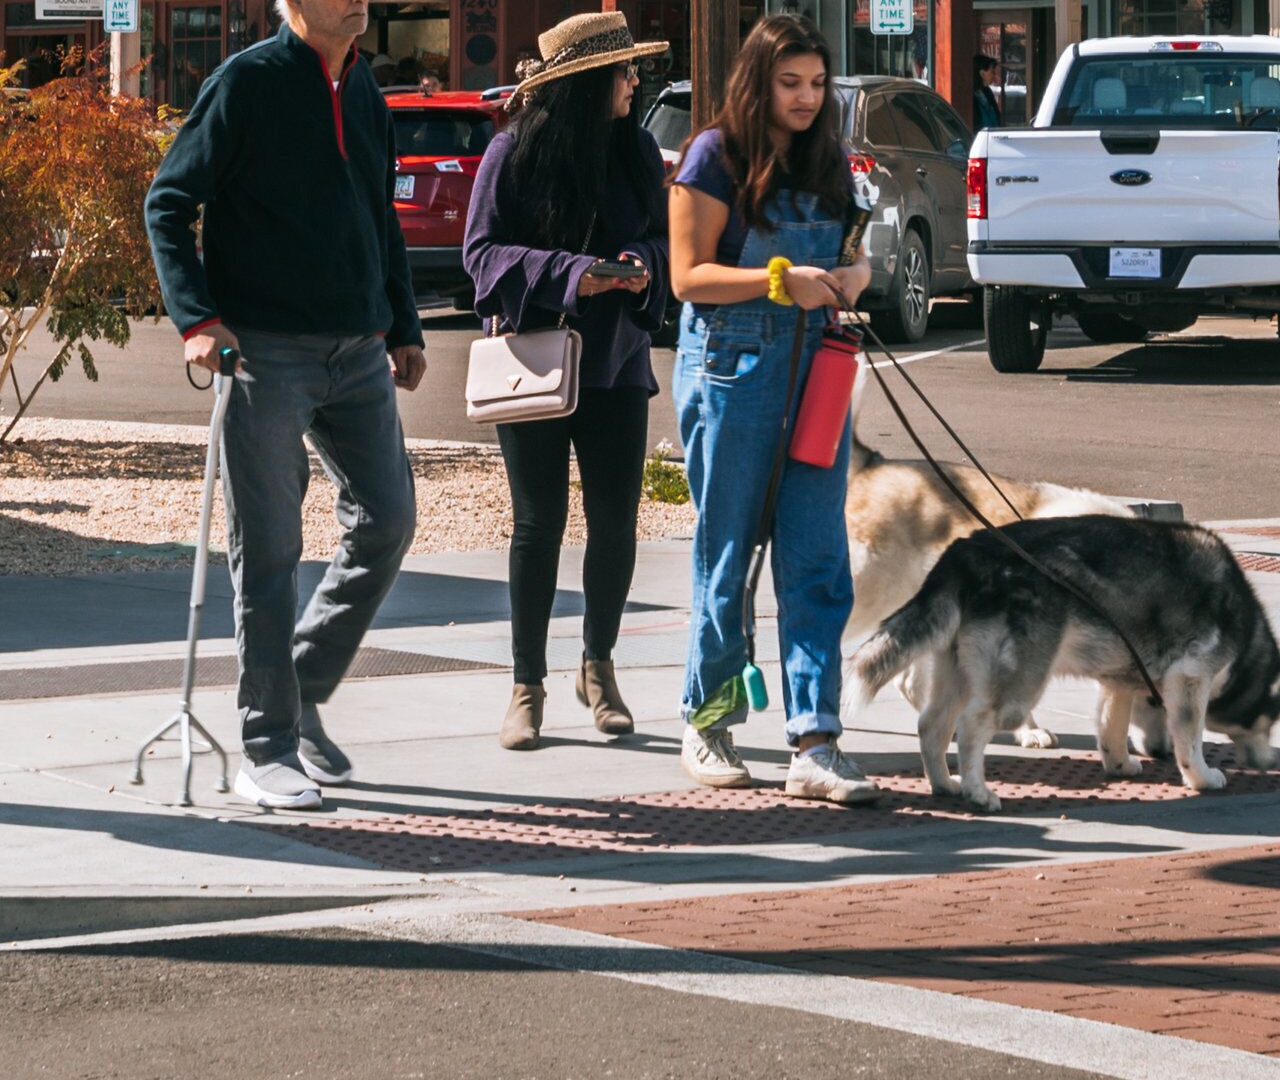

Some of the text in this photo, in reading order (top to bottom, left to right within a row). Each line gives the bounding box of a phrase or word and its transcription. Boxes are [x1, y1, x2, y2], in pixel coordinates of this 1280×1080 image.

[112, 2, 129, 10] ANY
[111, 11, 129, 20] TIME
[879, 9, 905, 20] TIME
